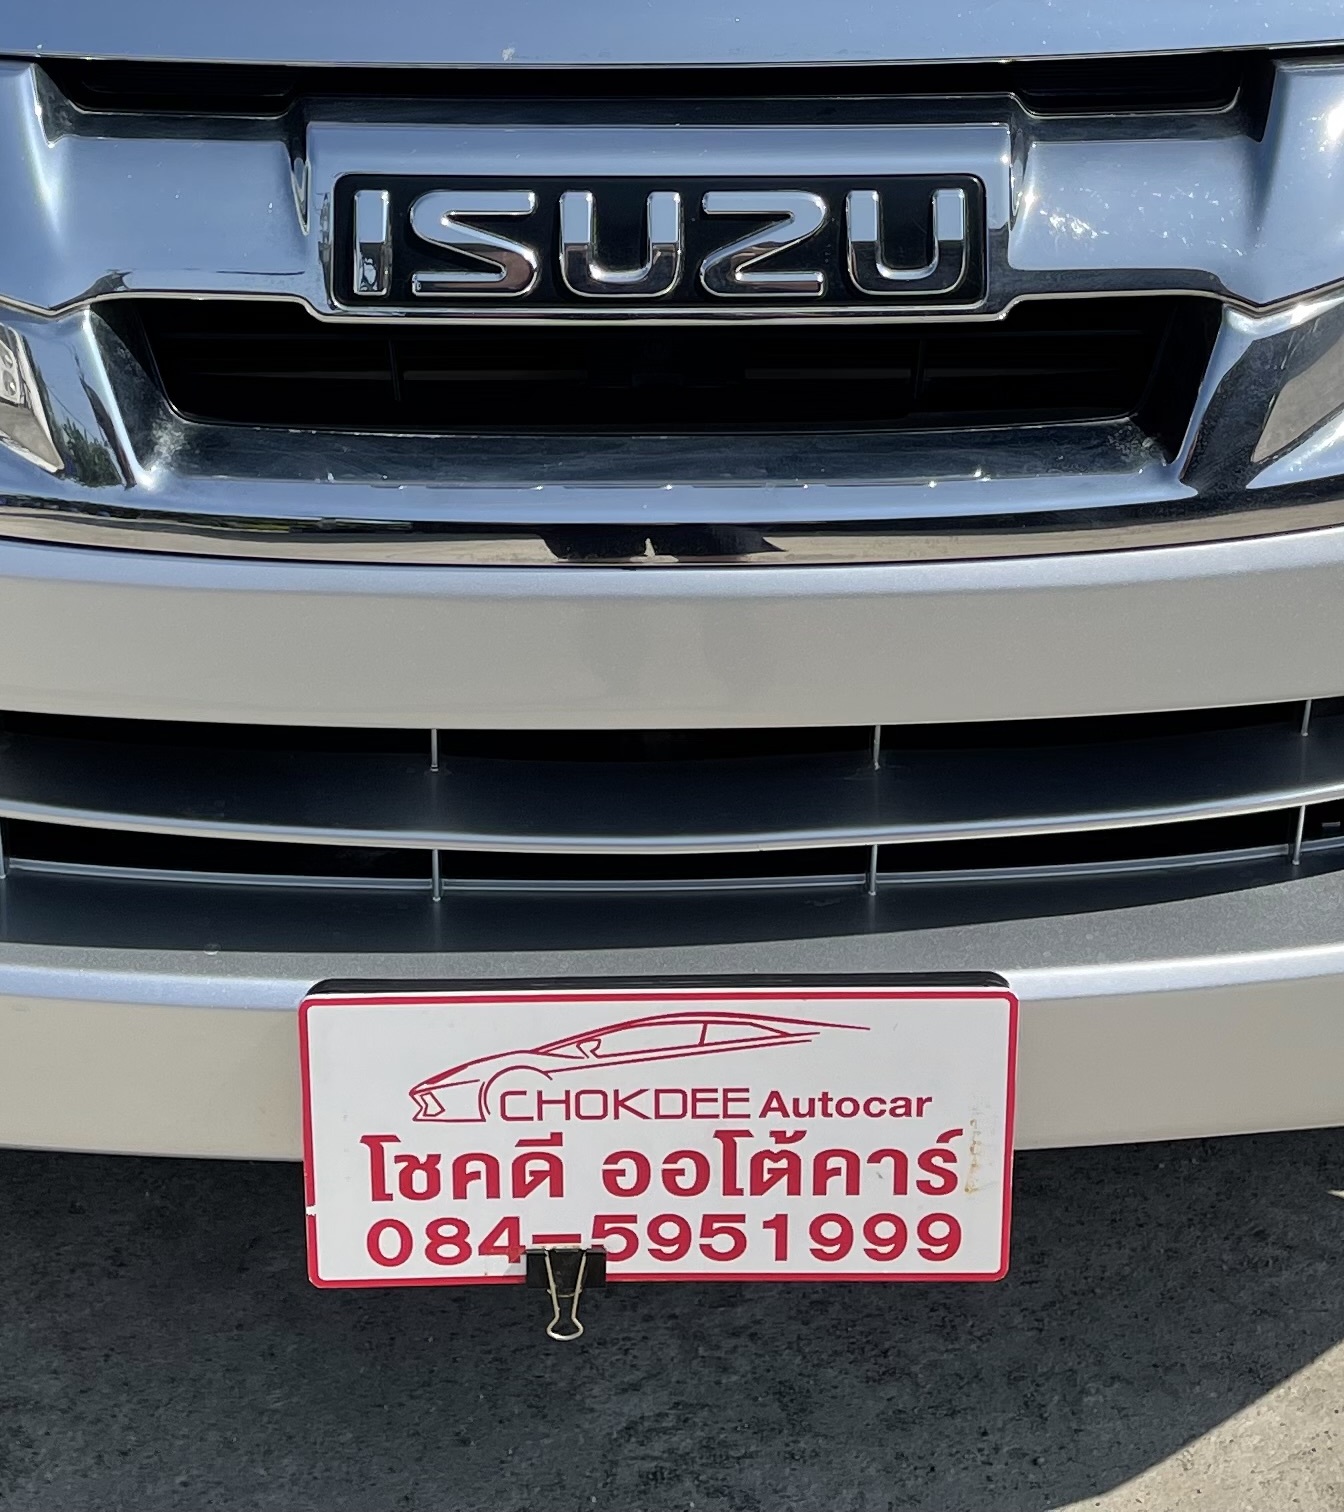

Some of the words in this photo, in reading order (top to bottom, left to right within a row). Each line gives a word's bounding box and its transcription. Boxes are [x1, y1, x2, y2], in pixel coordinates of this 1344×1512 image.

[353, 188, 966, 297] ISUZU
[499, 1088, 751, 1122] CHOKDEE
[759, 1090, 934, 1119] Autocar
[360, 1131, 565, 1202] โชคดี
[602, 1128, 964, 1199] ออโต้คาร์
[366, 1212, 963, 1268] 084-5951999
